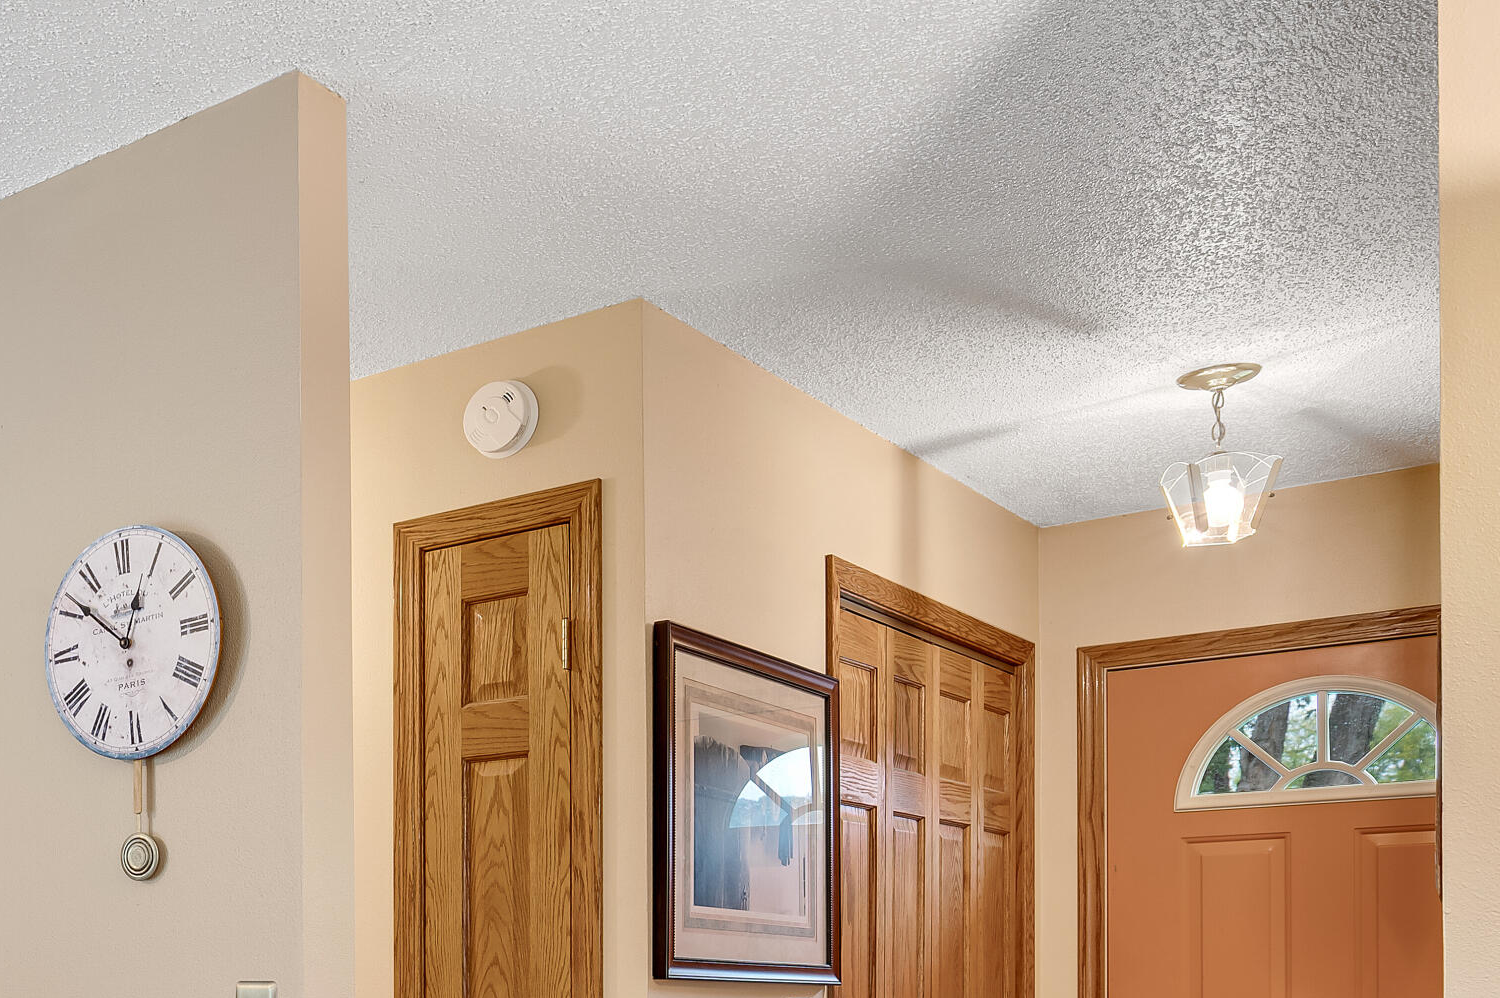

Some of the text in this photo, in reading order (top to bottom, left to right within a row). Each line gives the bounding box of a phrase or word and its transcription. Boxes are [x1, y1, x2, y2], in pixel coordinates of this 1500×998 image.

[168, 569, 196, 600] II
[92, 625, 118, 636] CAL
[134, 612, 164, 624] MARTIN
[180, 613, 209, 637] III
[118, 678, 146, 691] PARIS
